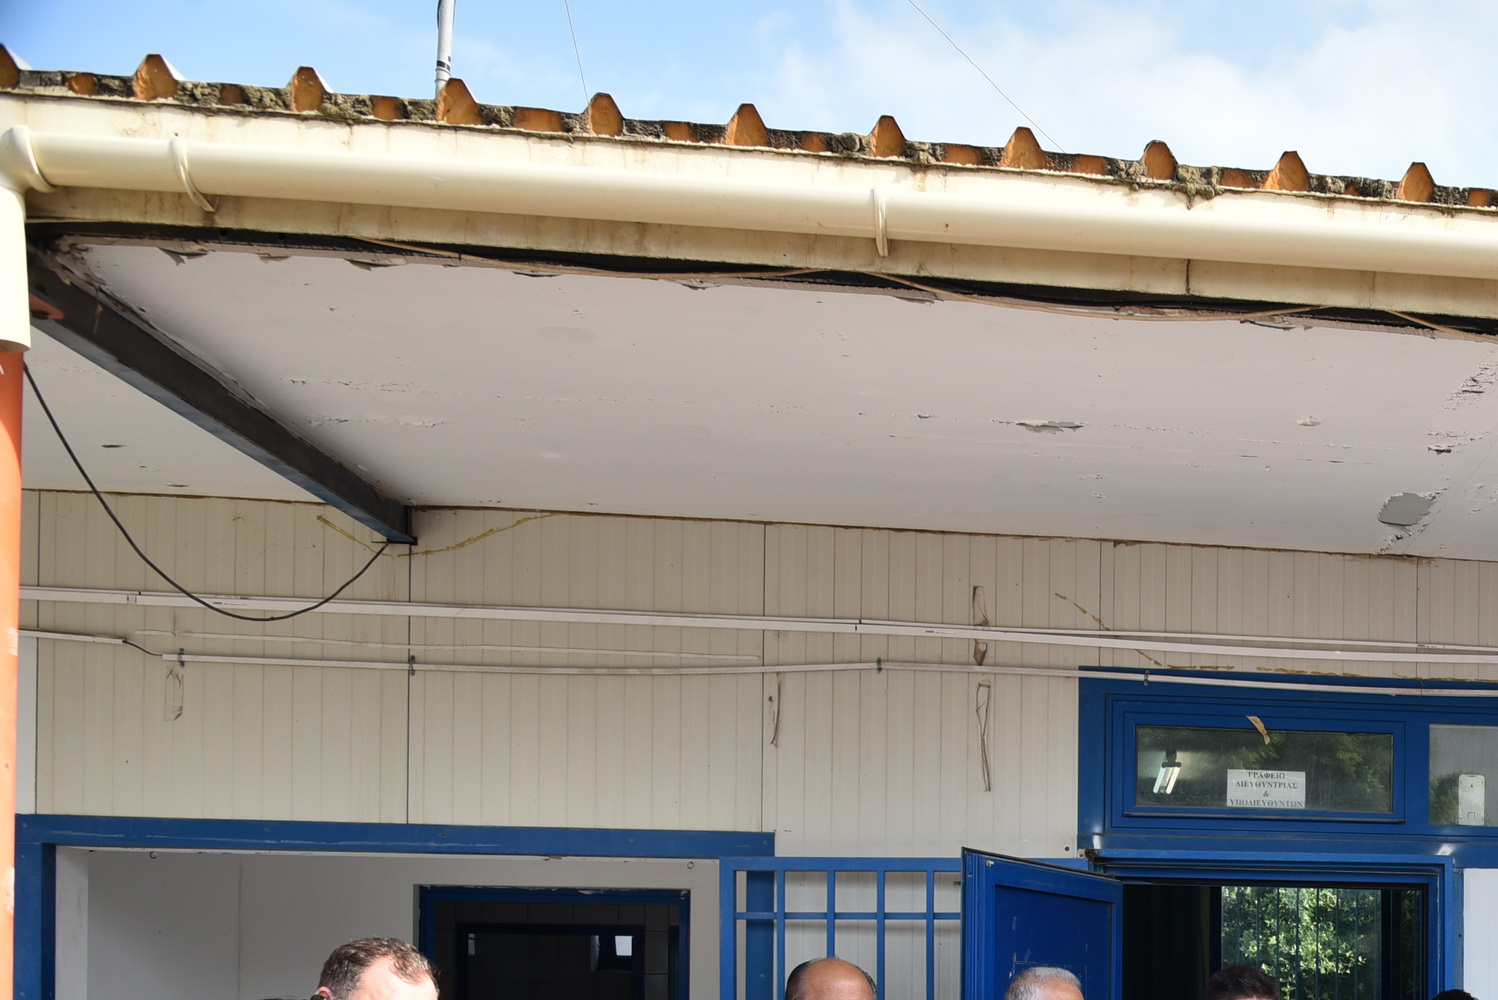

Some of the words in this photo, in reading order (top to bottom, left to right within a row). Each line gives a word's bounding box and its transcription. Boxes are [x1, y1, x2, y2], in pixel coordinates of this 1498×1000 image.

[1248, 771, 1285, 779] ΓΡΑΦΕΙΟ
[1236, 781, 1297, 789] ΔΙΕΥΘΥΝΤΡΙΑΣ
[1229, 799, 1303, 807] ΥΠΟΔΙΕΥΘΥΝΤΩΝ
